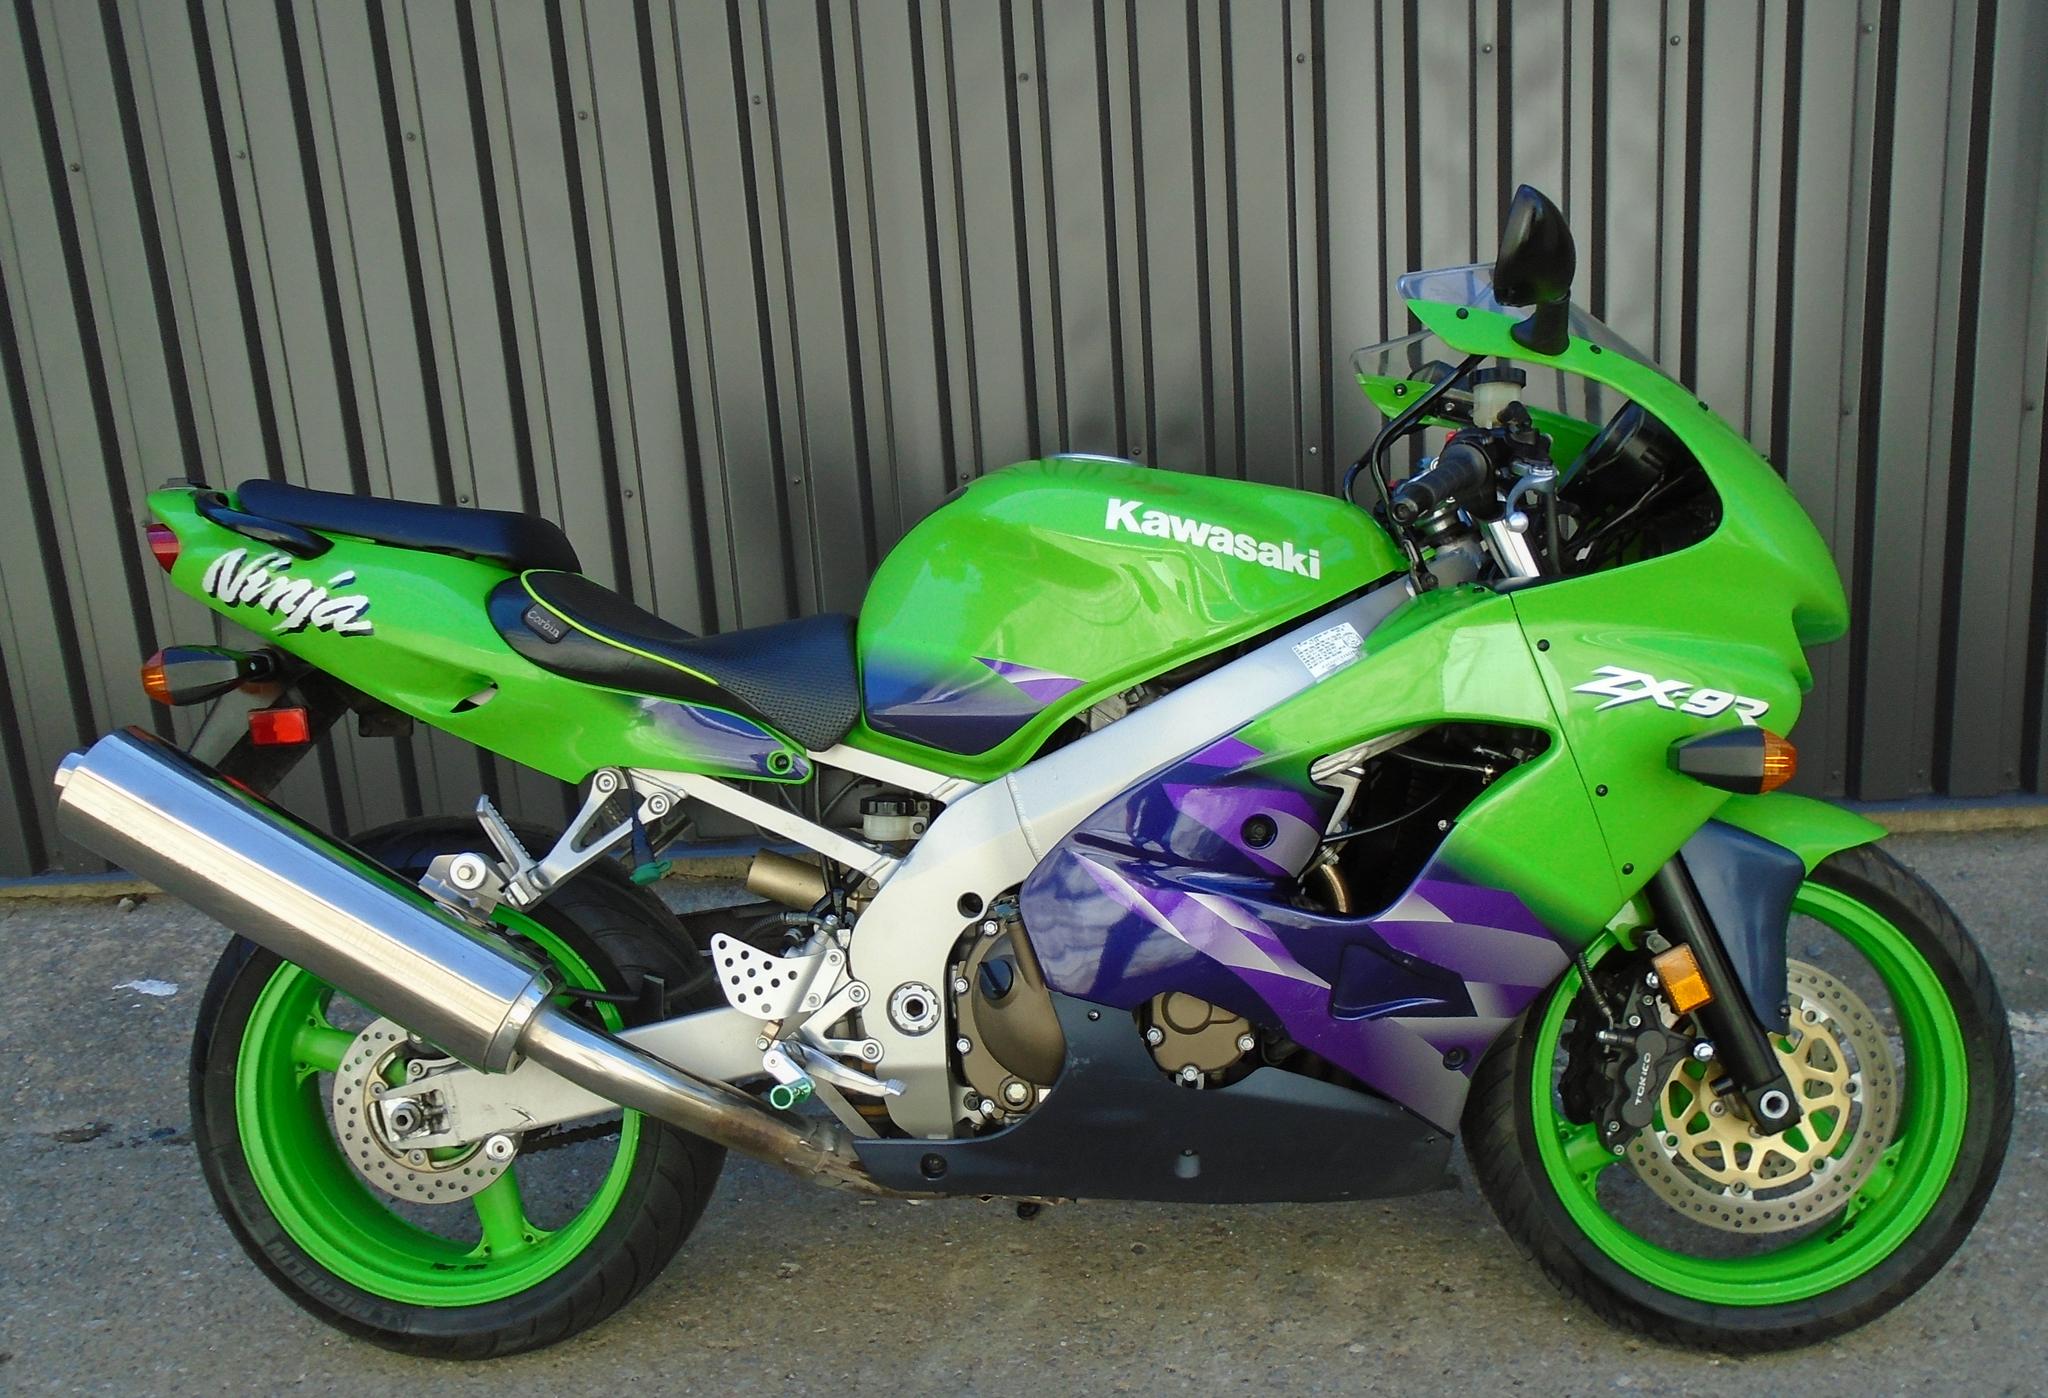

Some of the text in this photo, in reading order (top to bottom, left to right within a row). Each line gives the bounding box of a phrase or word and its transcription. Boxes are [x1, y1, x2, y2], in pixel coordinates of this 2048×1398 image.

[1104, 498, 1321, 580] Kawasaki
[202, 548, 373, 636] Ninja
[527, 610, 560, 638] Corbin
[1570, 665, 1770, 727] ZX-9R
[1634, 1052, 1651, 1106] TOKICO
